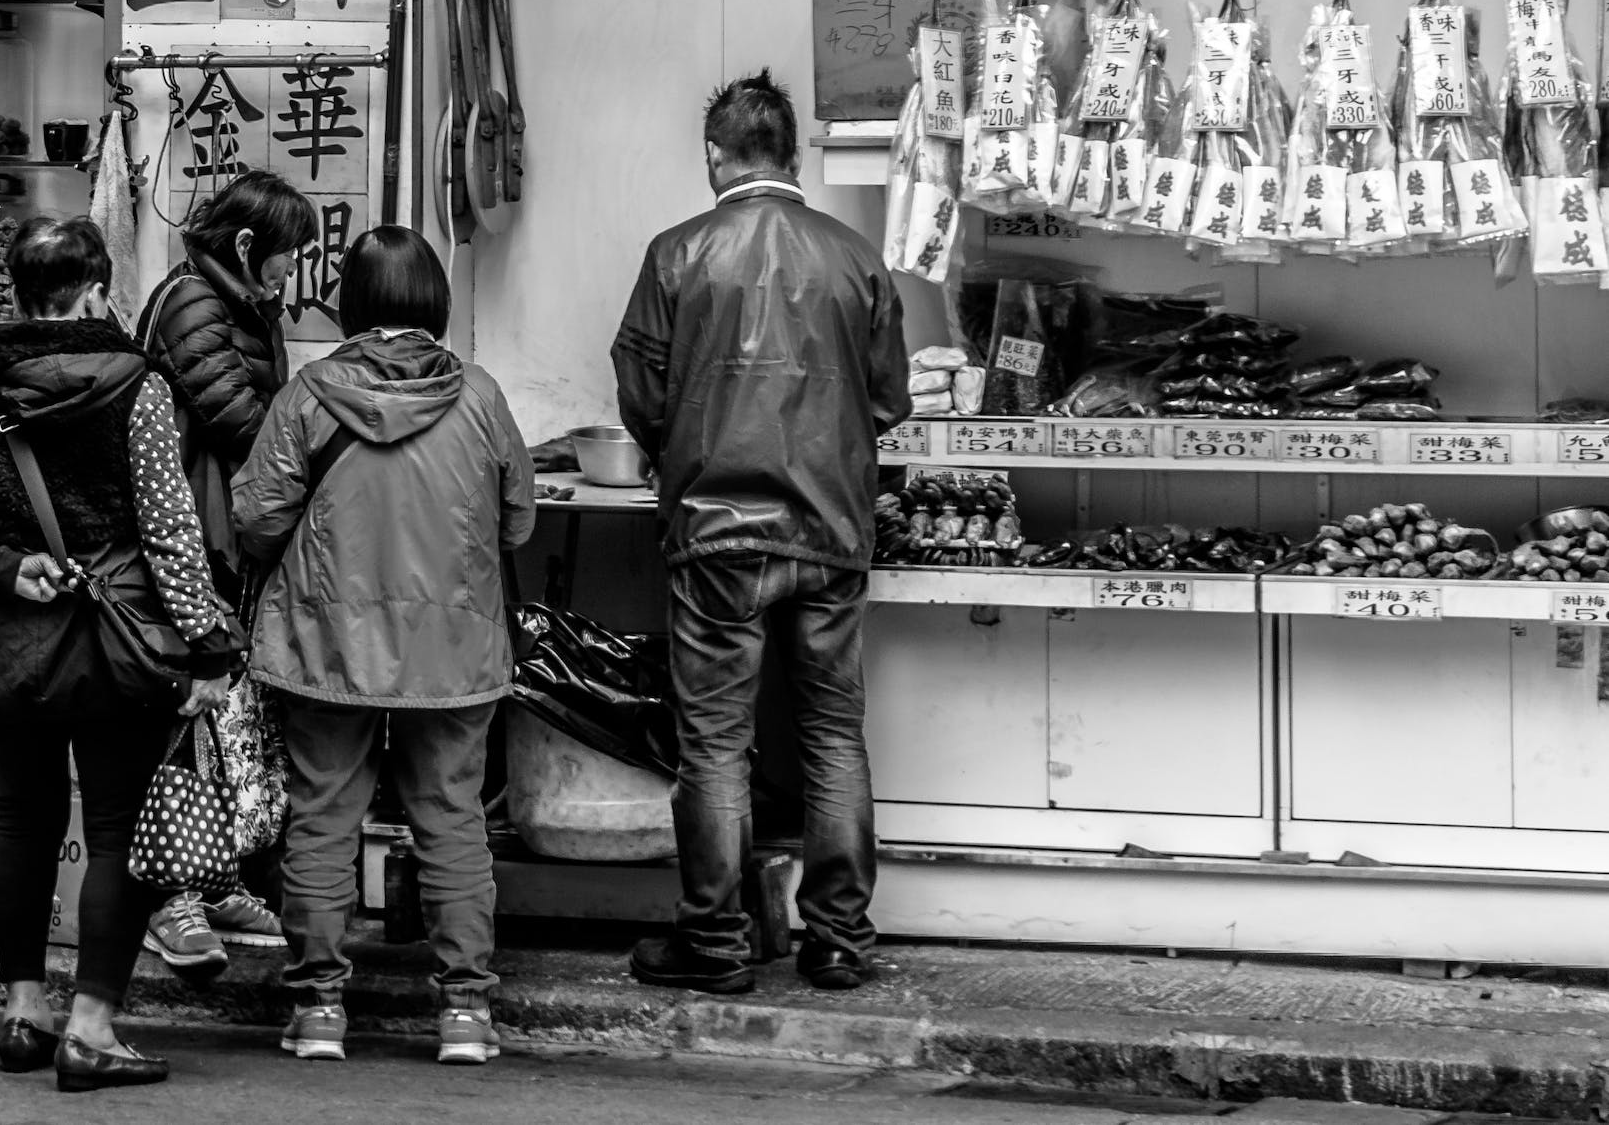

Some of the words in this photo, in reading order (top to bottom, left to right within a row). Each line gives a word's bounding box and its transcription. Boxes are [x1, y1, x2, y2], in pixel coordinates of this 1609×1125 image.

[932, 31, 957, 112] 大紅魚
[1529, 79, 1556, 98] 280
[1093, 99, 1117, 117] 240
[1335, 105, 1366, 124] 330
[180, 64, 366, 183] 金華
[989, 107, 1014, 126] 210
[1004, 224, 1061, 236] 240
[1003, 354, 1024, 370] 86
[1062, 426, 1146, 442] 特大柴魚
[1287, 431, 1372, 447] 甜梅菜
[1417, 434, 1505, 450] 甜梅菜
[968, 438, 1015, 453] 54
[1072, 440, 1124, 454] 56
[1193, 442, 1247, 458] 90
[1299, 444, 1352, 460] 30
[1429, 448, 1482, 463] 33
[1100, 579, 1188, 595] 本港臘肉
[1111, 593, 1166, 608] 76
[1343, 588, 1434, 604] 甜梅菜
[1356, 602, 1411, 618] 40
